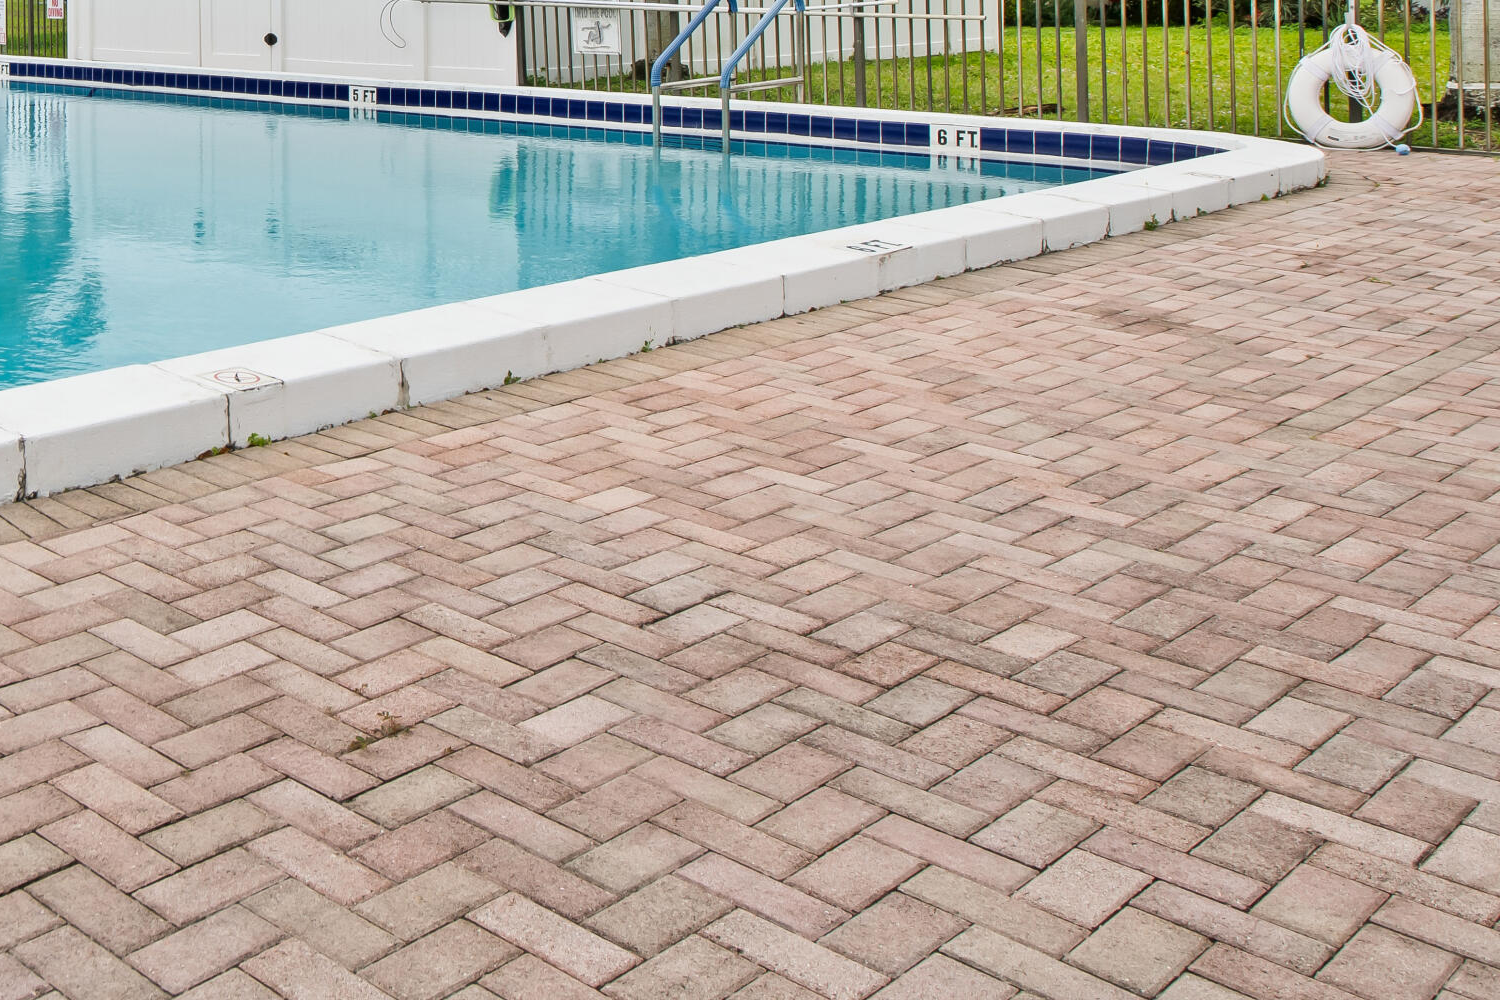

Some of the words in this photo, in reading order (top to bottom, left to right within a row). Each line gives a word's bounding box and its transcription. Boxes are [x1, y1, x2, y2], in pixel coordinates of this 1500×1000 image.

[48, 8, 62, 17] DIVING
[353, 89, 359, 101] 5
[937, 128, 948, 146] 6
[956, 129, 978, 148] FT.
